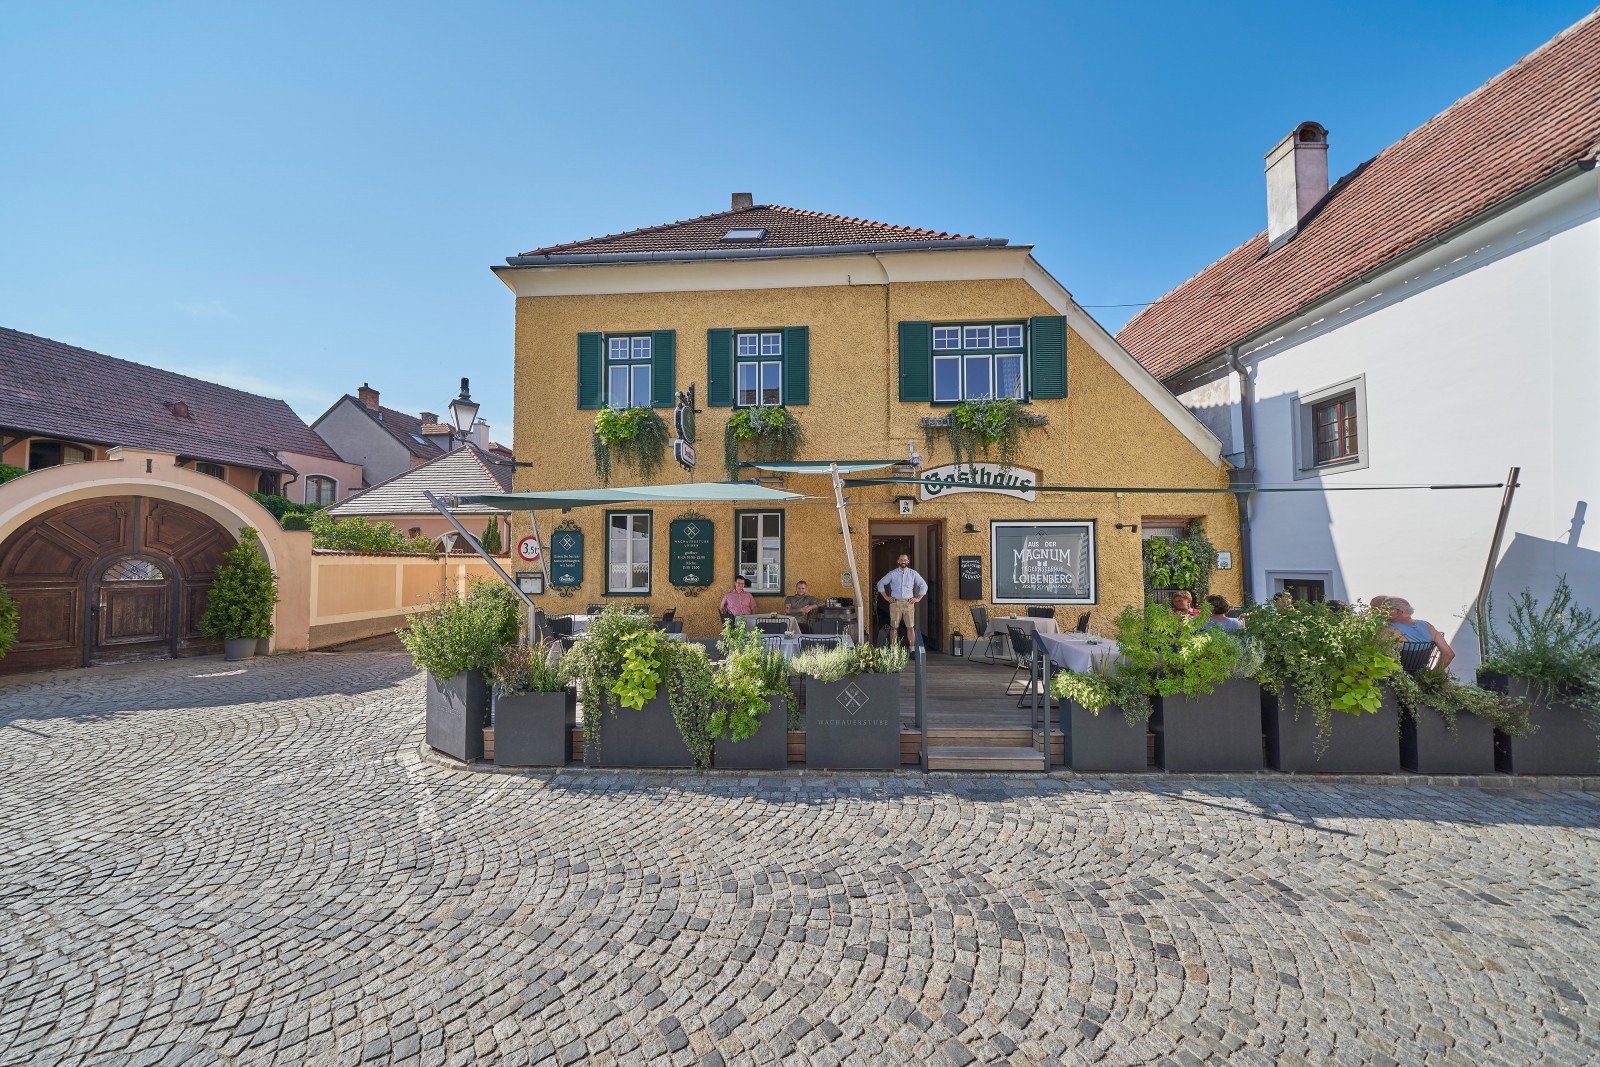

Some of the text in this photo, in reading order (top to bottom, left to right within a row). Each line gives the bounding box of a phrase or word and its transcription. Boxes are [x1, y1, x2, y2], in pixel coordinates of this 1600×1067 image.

[924, 466, 1032, 495] Gasthaus
[1013, 548, 1071, 567] MAGNUM
[1013, 574, 1073, 584] LOIBENBERG
